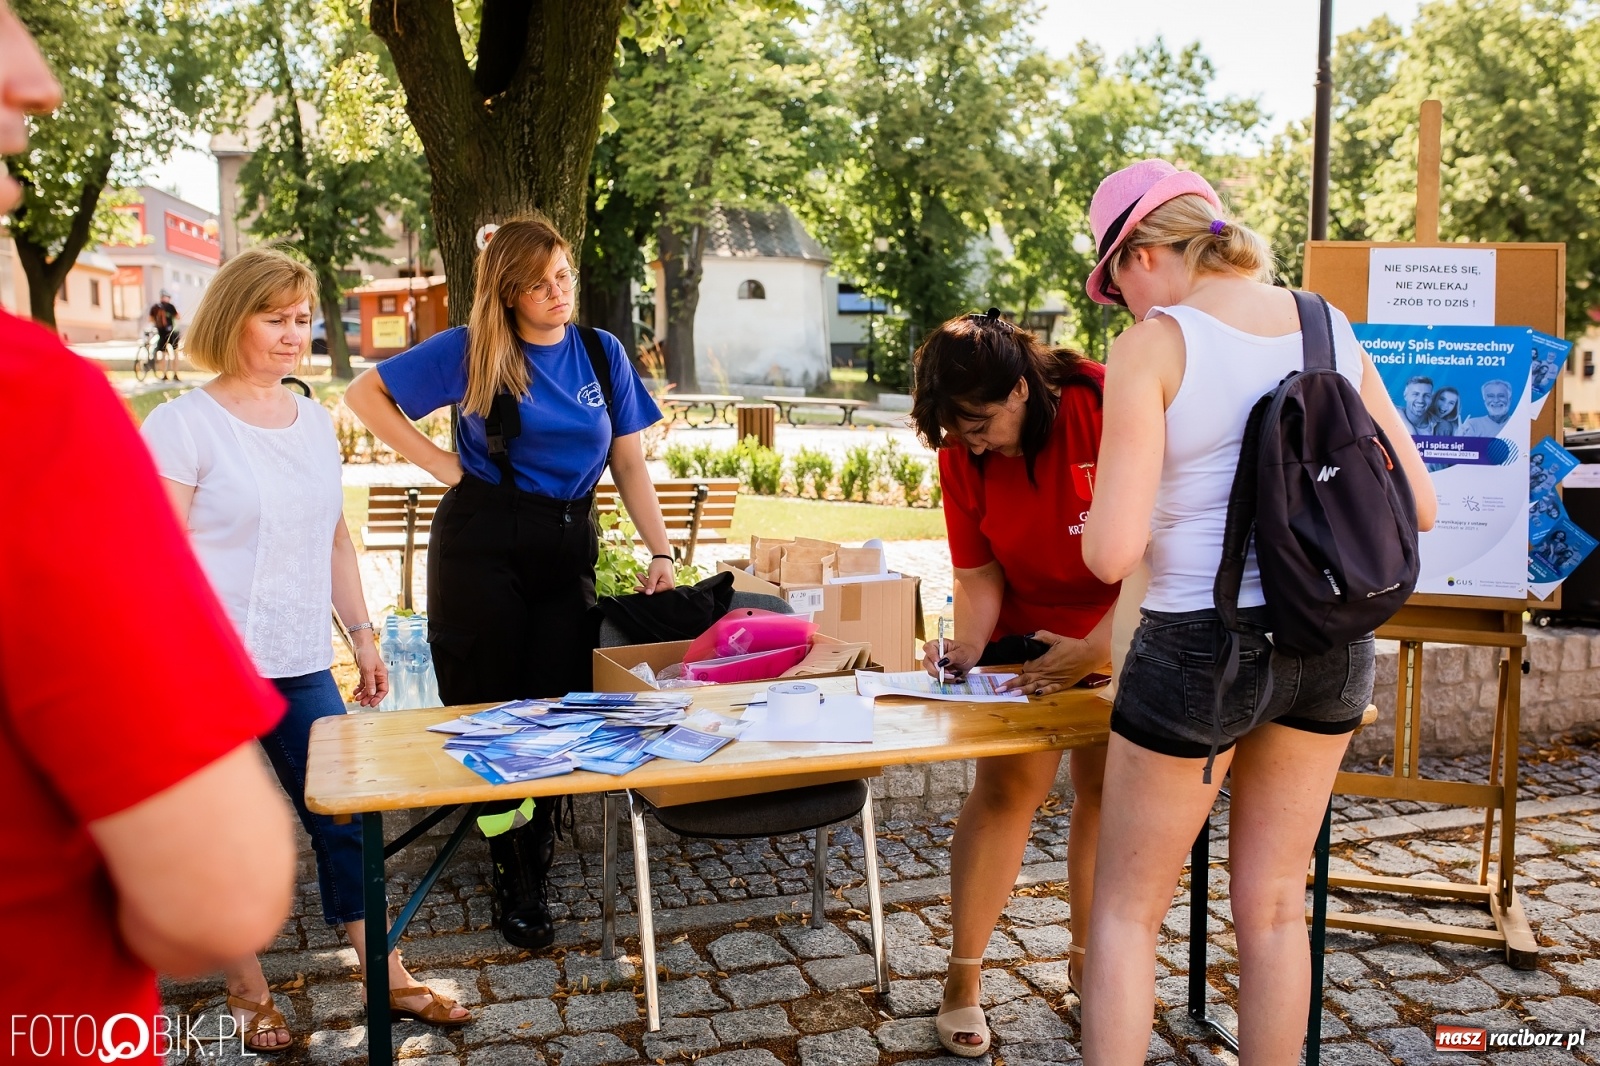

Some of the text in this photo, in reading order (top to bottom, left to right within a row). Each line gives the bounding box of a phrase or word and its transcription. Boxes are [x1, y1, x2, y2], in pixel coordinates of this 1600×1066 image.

[1384, 263, 1481, 275] NIE SPISAŁEŚ SIĘ,
[1395, 281, 1469, 291] NIE ZWLEKAJ
[1393, 296, 1424, 307] ZRÓB
[1426, 298, 1442, 307] TO
[1444, 297, 1469, 308] DZIŚ
[1359, 338, 1515, 354] rodowy Spis Powszechny
[1408, 354, 1412, 364] i
[1416, 354, 1473, 366] Mieszkań
[1476, 355, 1506, 367] 2021
[1416, 441, 1425, 450] pl
[1430, 441, 1449, 450] spisz
[1450, 442, 1464, 451] się!
